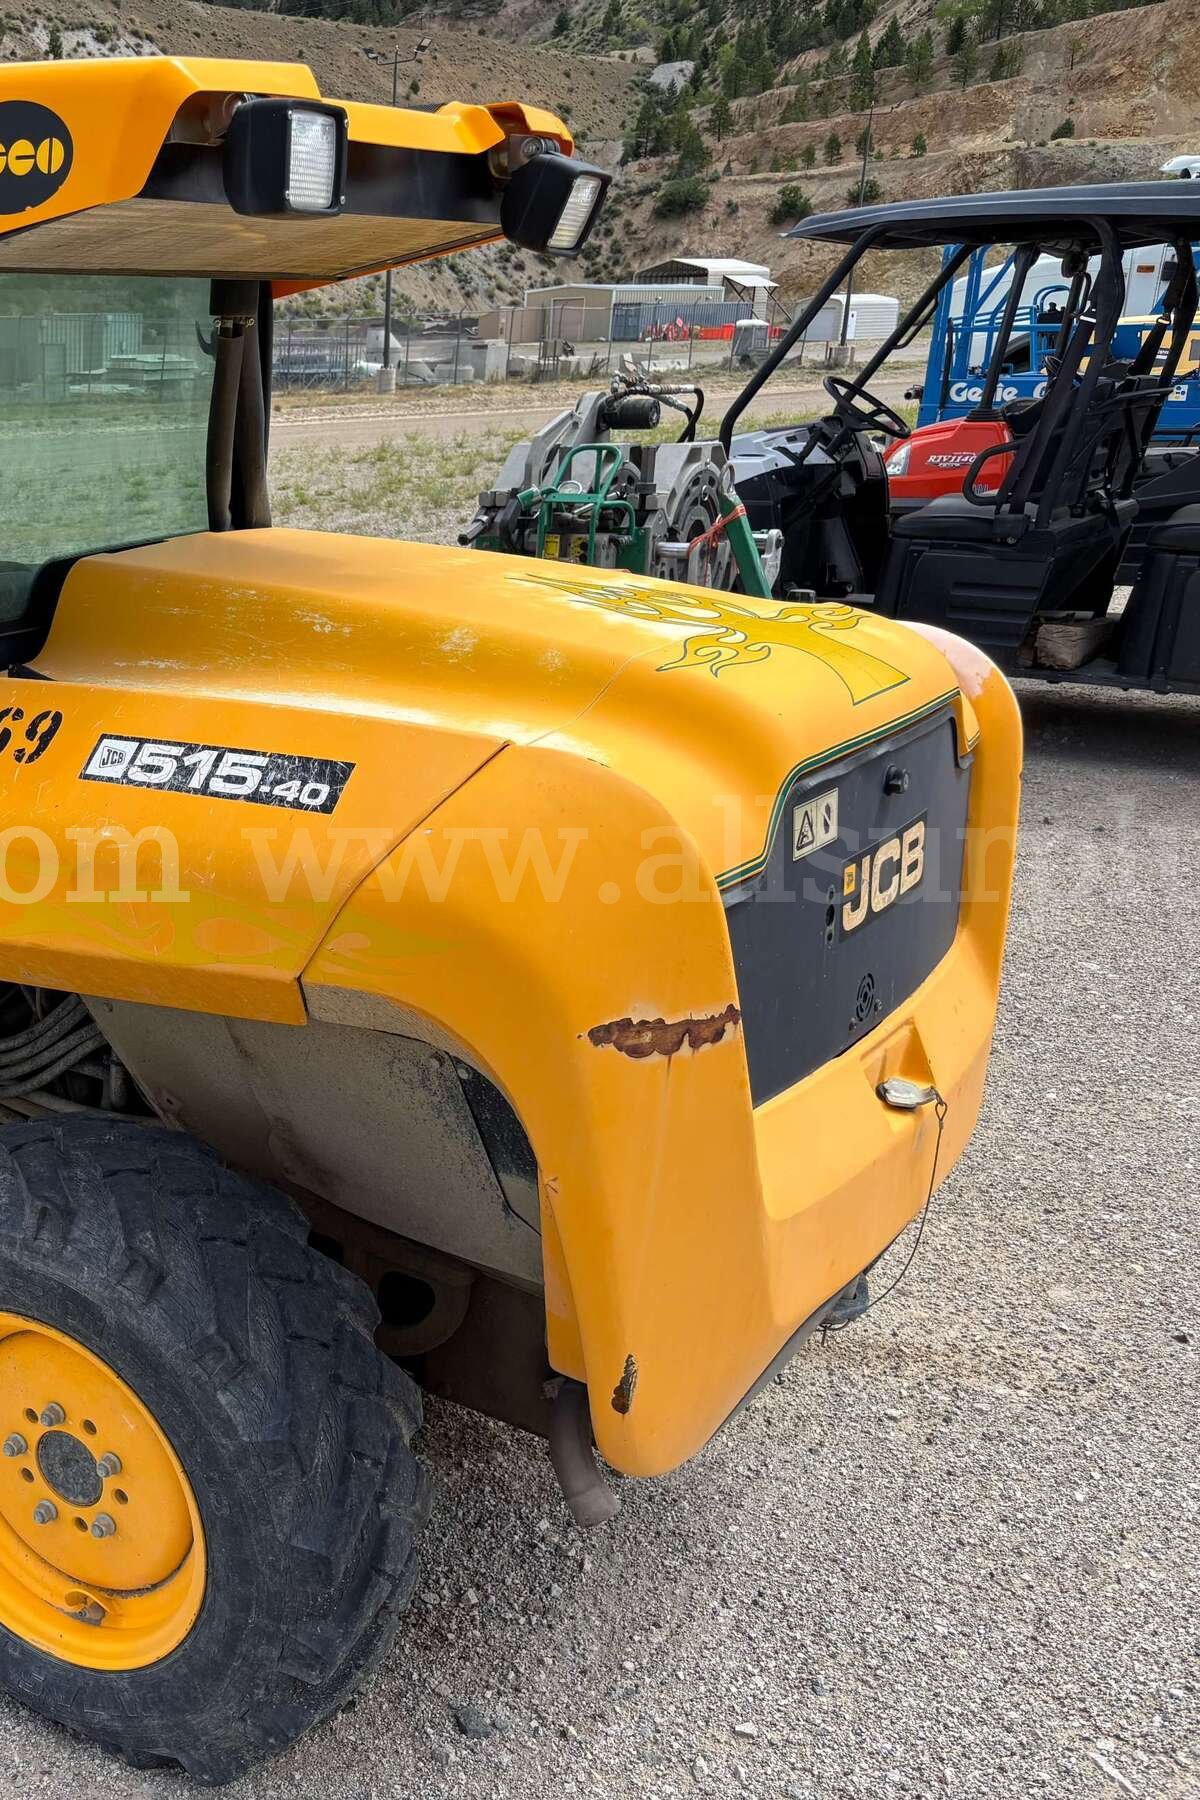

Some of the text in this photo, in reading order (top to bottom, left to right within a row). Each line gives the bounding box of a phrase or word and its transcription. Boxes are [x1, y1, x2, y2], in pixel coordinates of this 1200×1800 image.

[949, 382, 1019, 402] Geie
[102, 747, 124, 766] JCB
[842, 820, 925, 931] JCB
